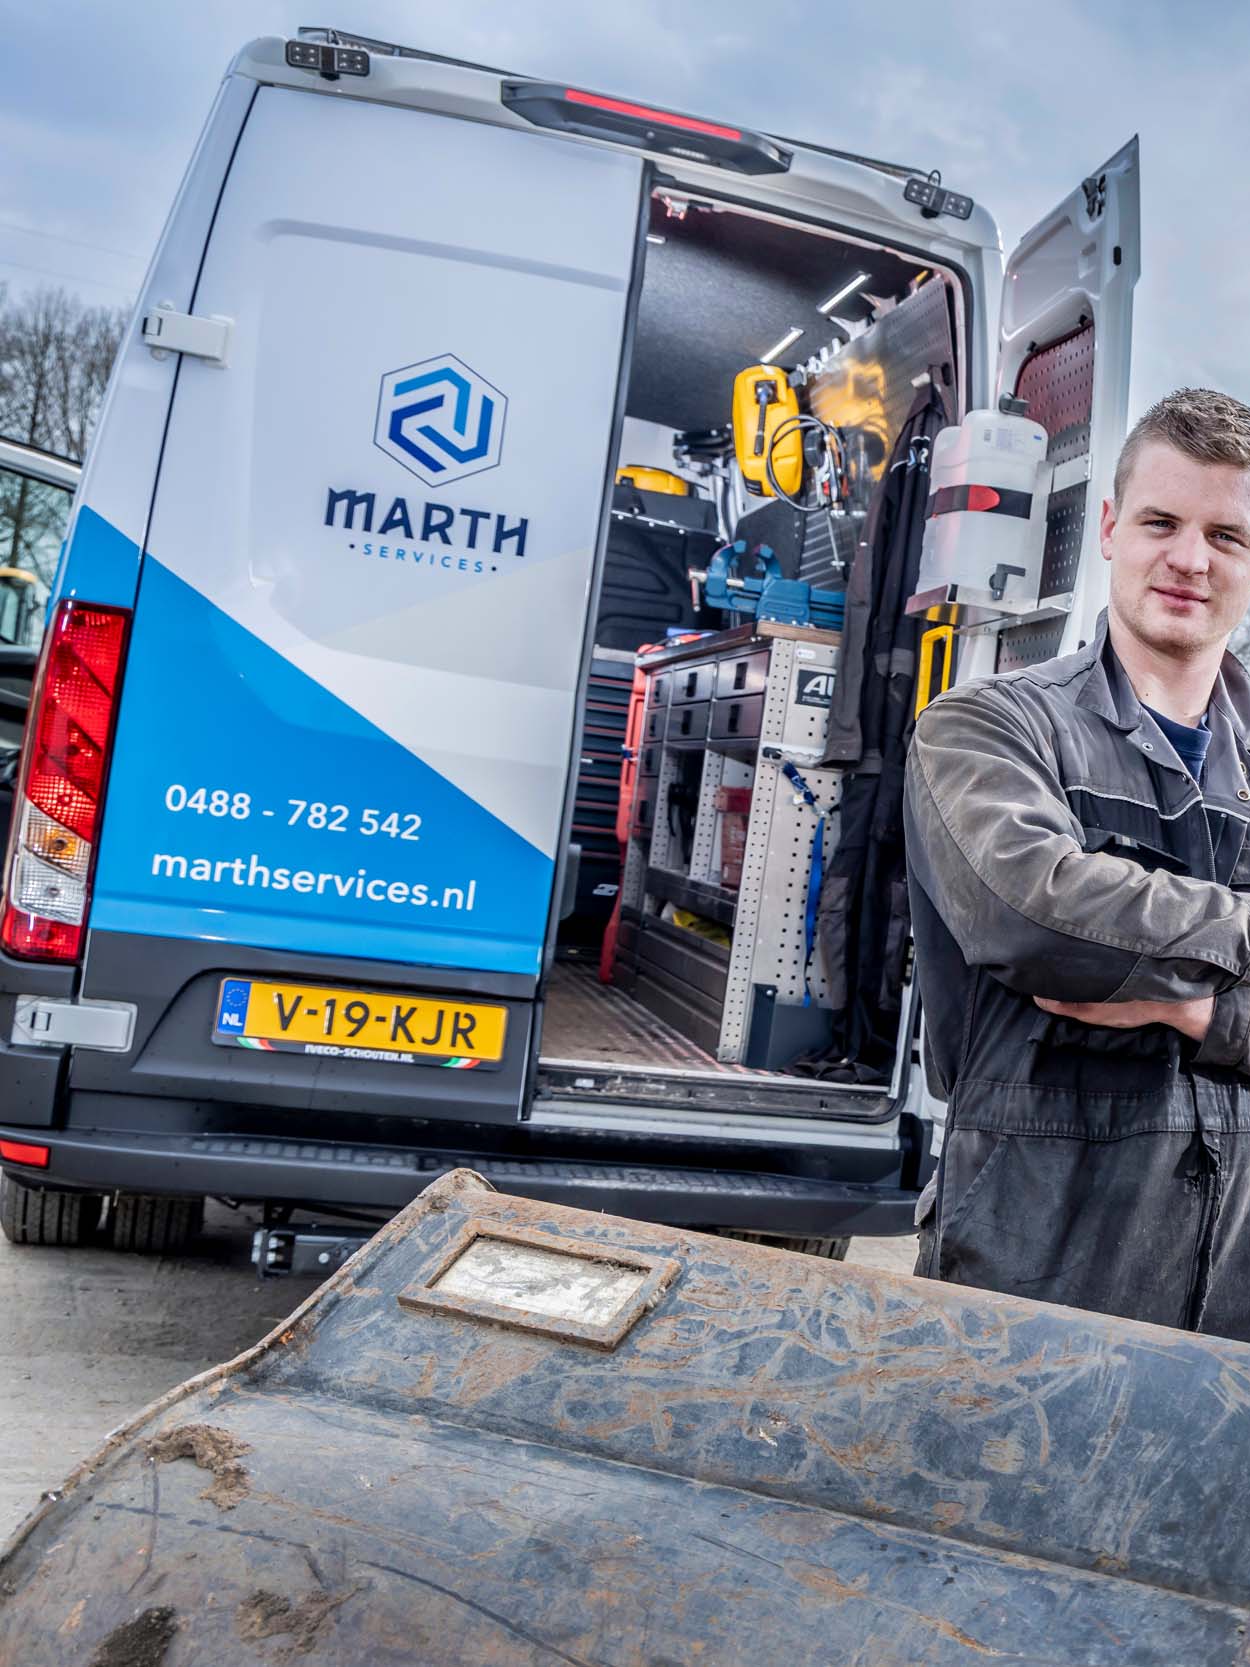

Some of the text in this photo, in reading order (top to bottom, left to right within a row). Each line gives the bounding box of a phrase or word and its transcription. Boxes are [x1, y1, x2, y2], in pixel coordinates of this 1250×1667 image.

[363, 543, 484, 573] SERVICES
[165, 784, 251, 820] 0488
[286, 799, 349, 832] 782
[359, 808, 423, 841] 542
[151, 853, 477, 911] marthservices.nl
[222, 1011, 243, 1027] NL
[276, 992, 476, 1050] V-19-KJR
